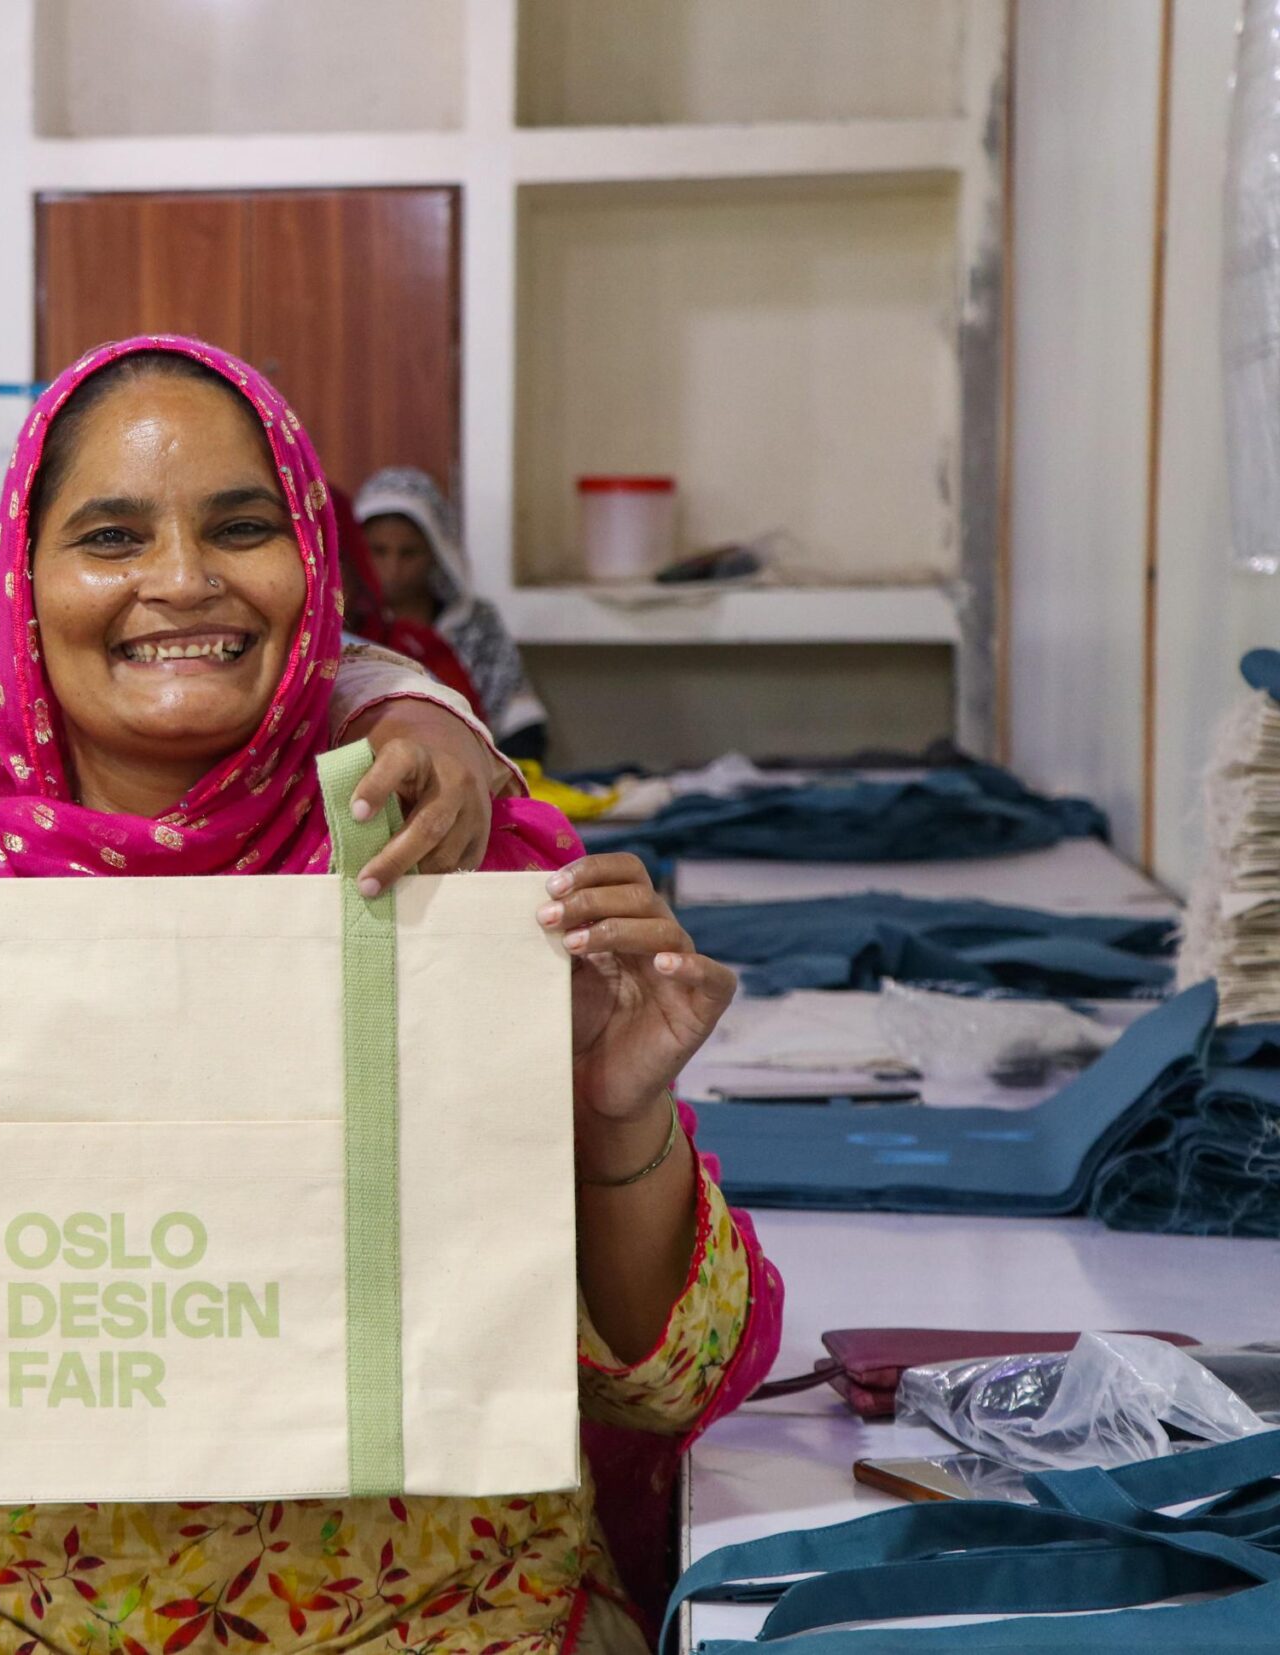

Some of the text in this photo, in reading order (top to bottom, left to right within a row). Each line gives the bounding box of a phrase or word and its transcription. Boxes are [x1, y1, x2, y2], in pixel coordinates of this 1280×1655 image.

[4, 1212, 208, 1270] OSLO
[8, 1282, 280, 1339] DESIGN
[8, 1351, 166, 1408] FAIR
